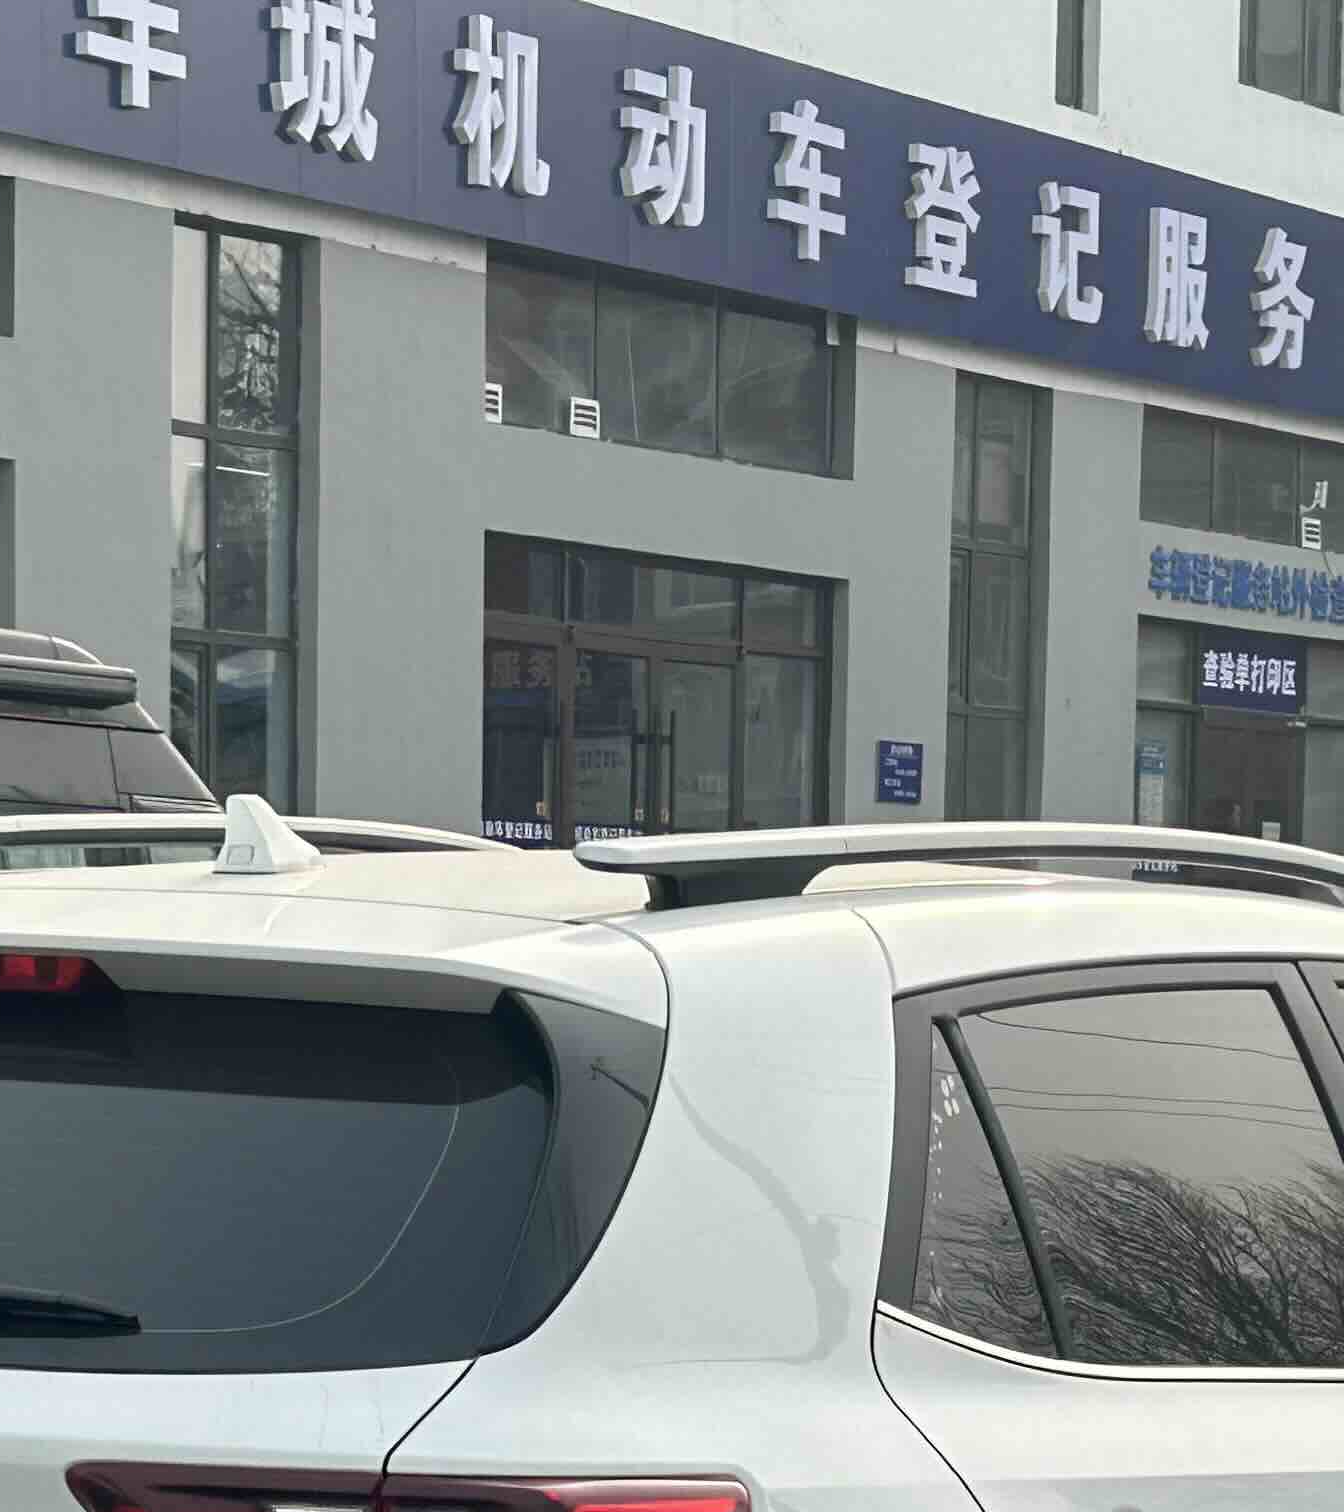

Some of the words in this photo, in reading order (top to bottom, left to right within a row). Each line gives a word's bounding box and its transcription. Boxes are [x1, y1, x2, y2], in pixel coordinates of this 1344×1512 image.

[1203, 649, 1297, 695] 查验单打印区
